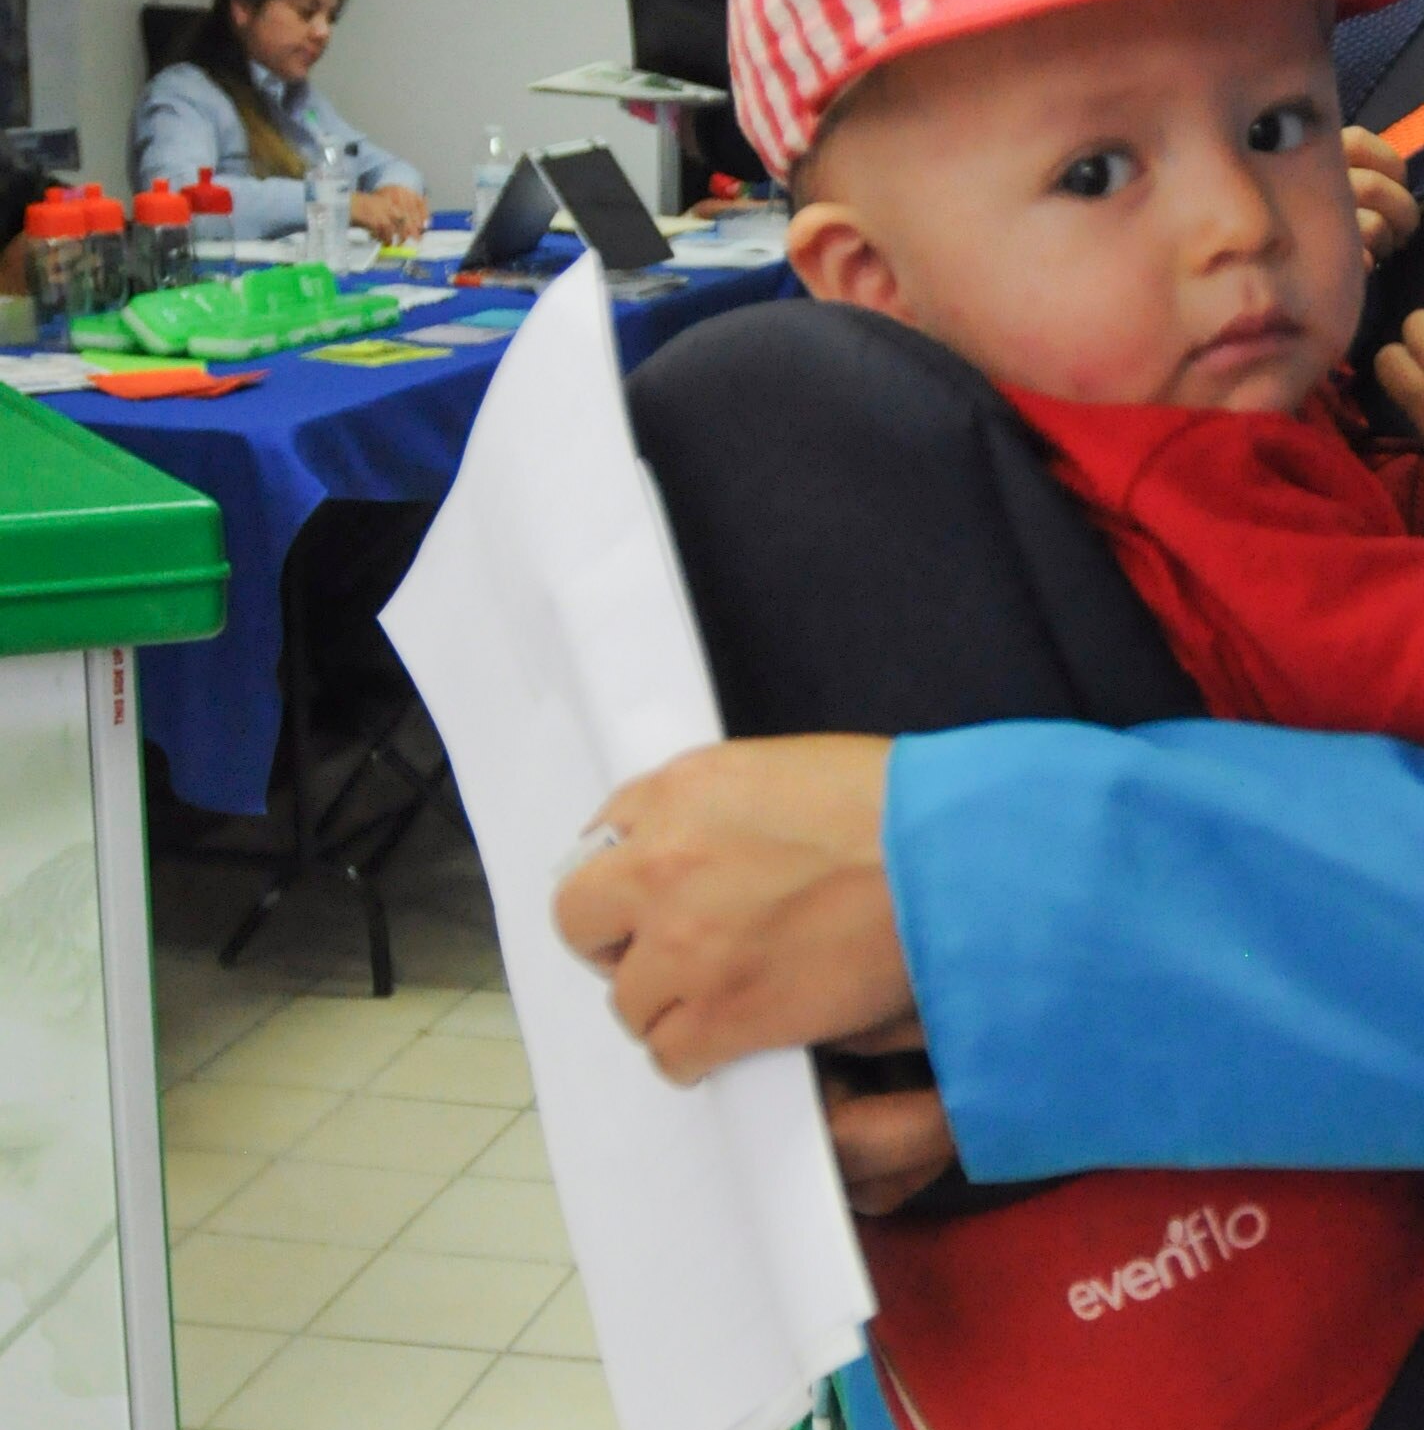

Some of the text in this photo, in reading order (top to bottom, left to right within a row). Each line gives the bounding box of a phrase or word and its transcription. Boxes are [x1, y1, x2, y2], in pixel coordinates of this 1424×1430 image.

[112, 669, 124, 696] SIDE
[112, 698, 125, 725] THIS
[1067, 1202, 1268, 1321] evenflo
